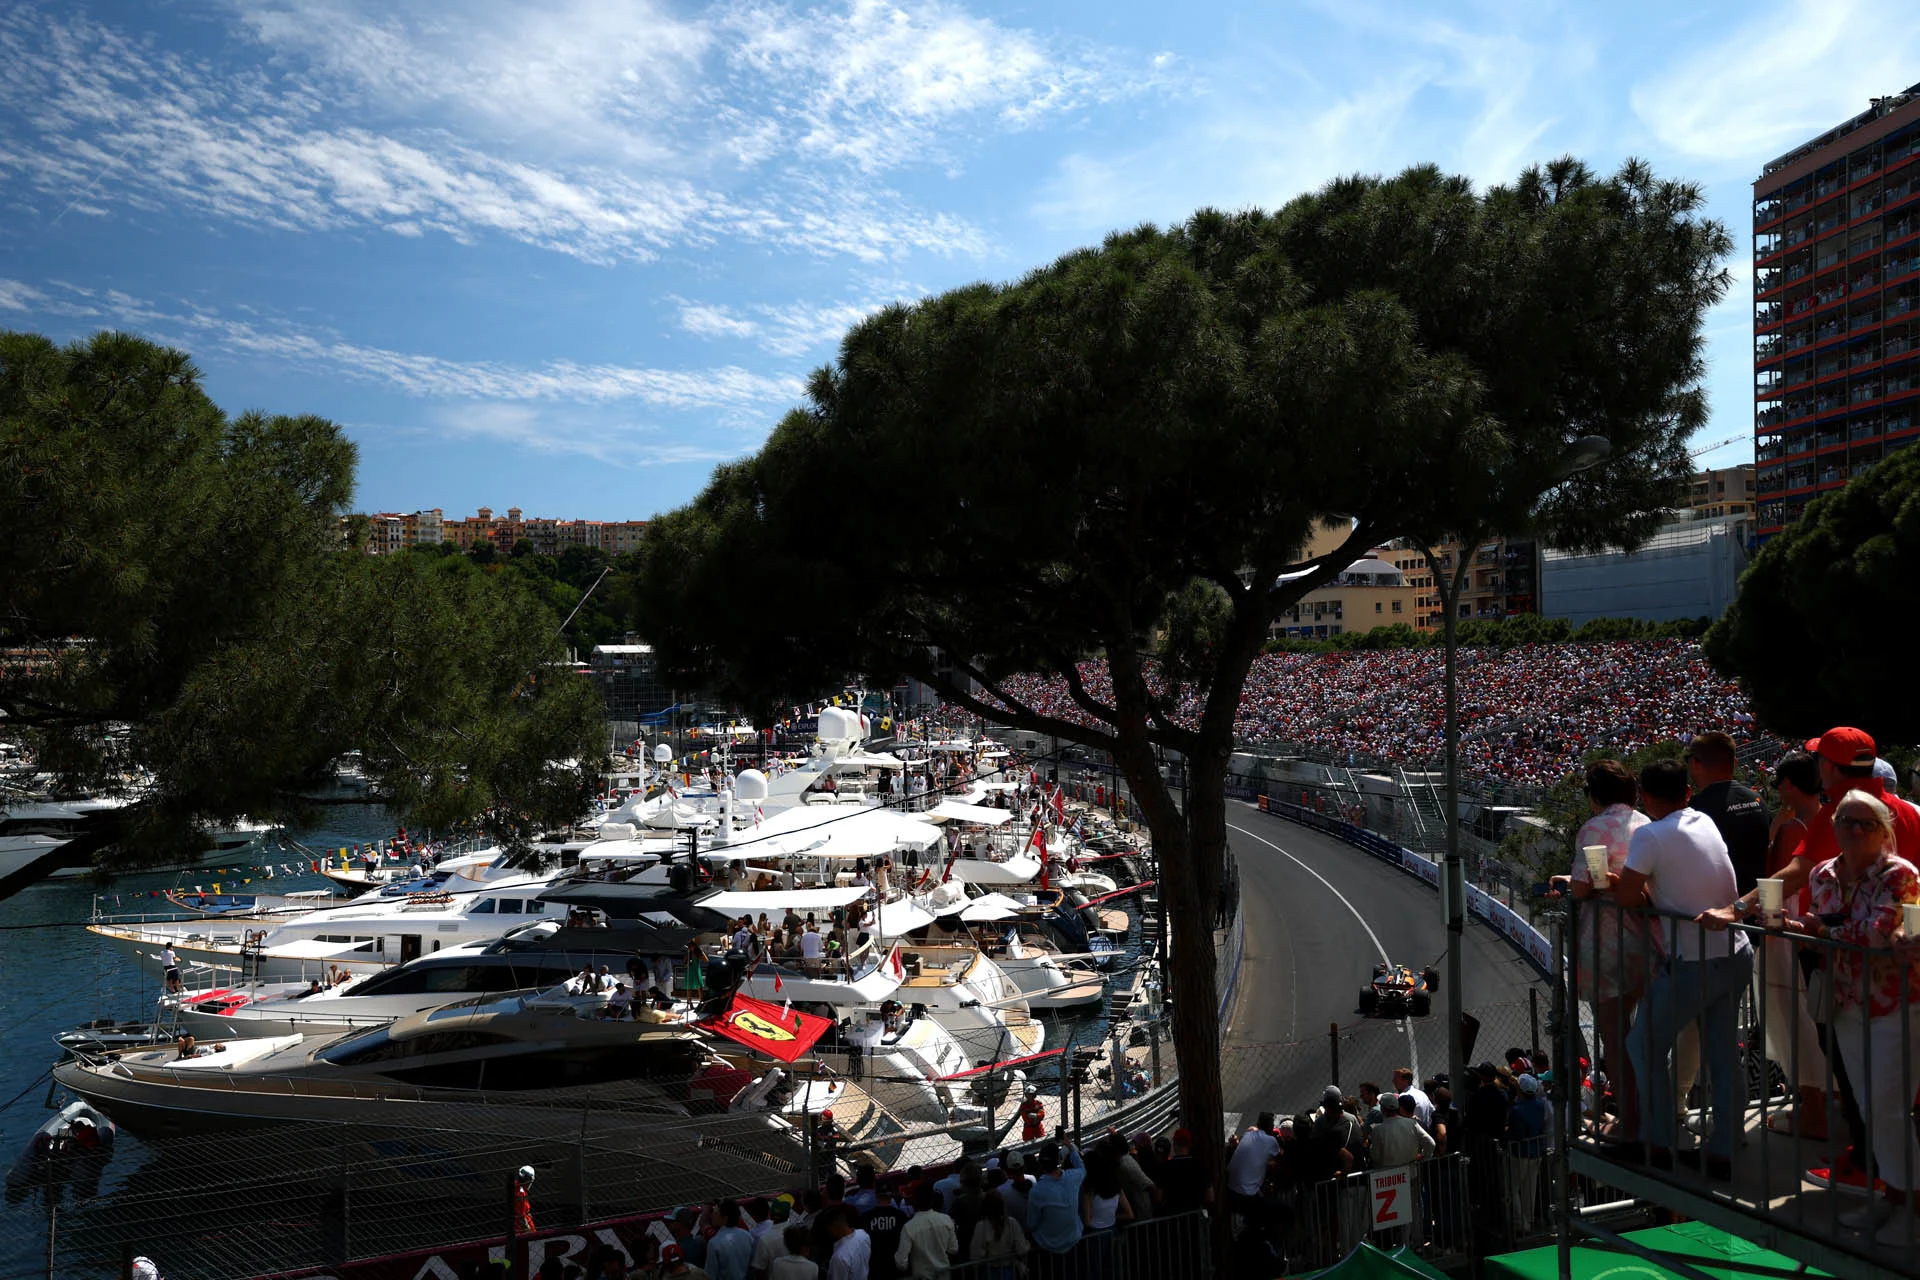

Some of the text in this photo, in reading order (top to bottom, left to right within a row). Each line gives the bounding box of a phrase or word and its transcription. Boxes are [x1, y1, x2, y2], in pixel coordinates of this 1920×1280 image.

[1726, 801, 1760, 812] McLaren
[1375, 1173, 1407, 1189] TRIBUNE
[1375, 1189, 1398, 1223] Z
